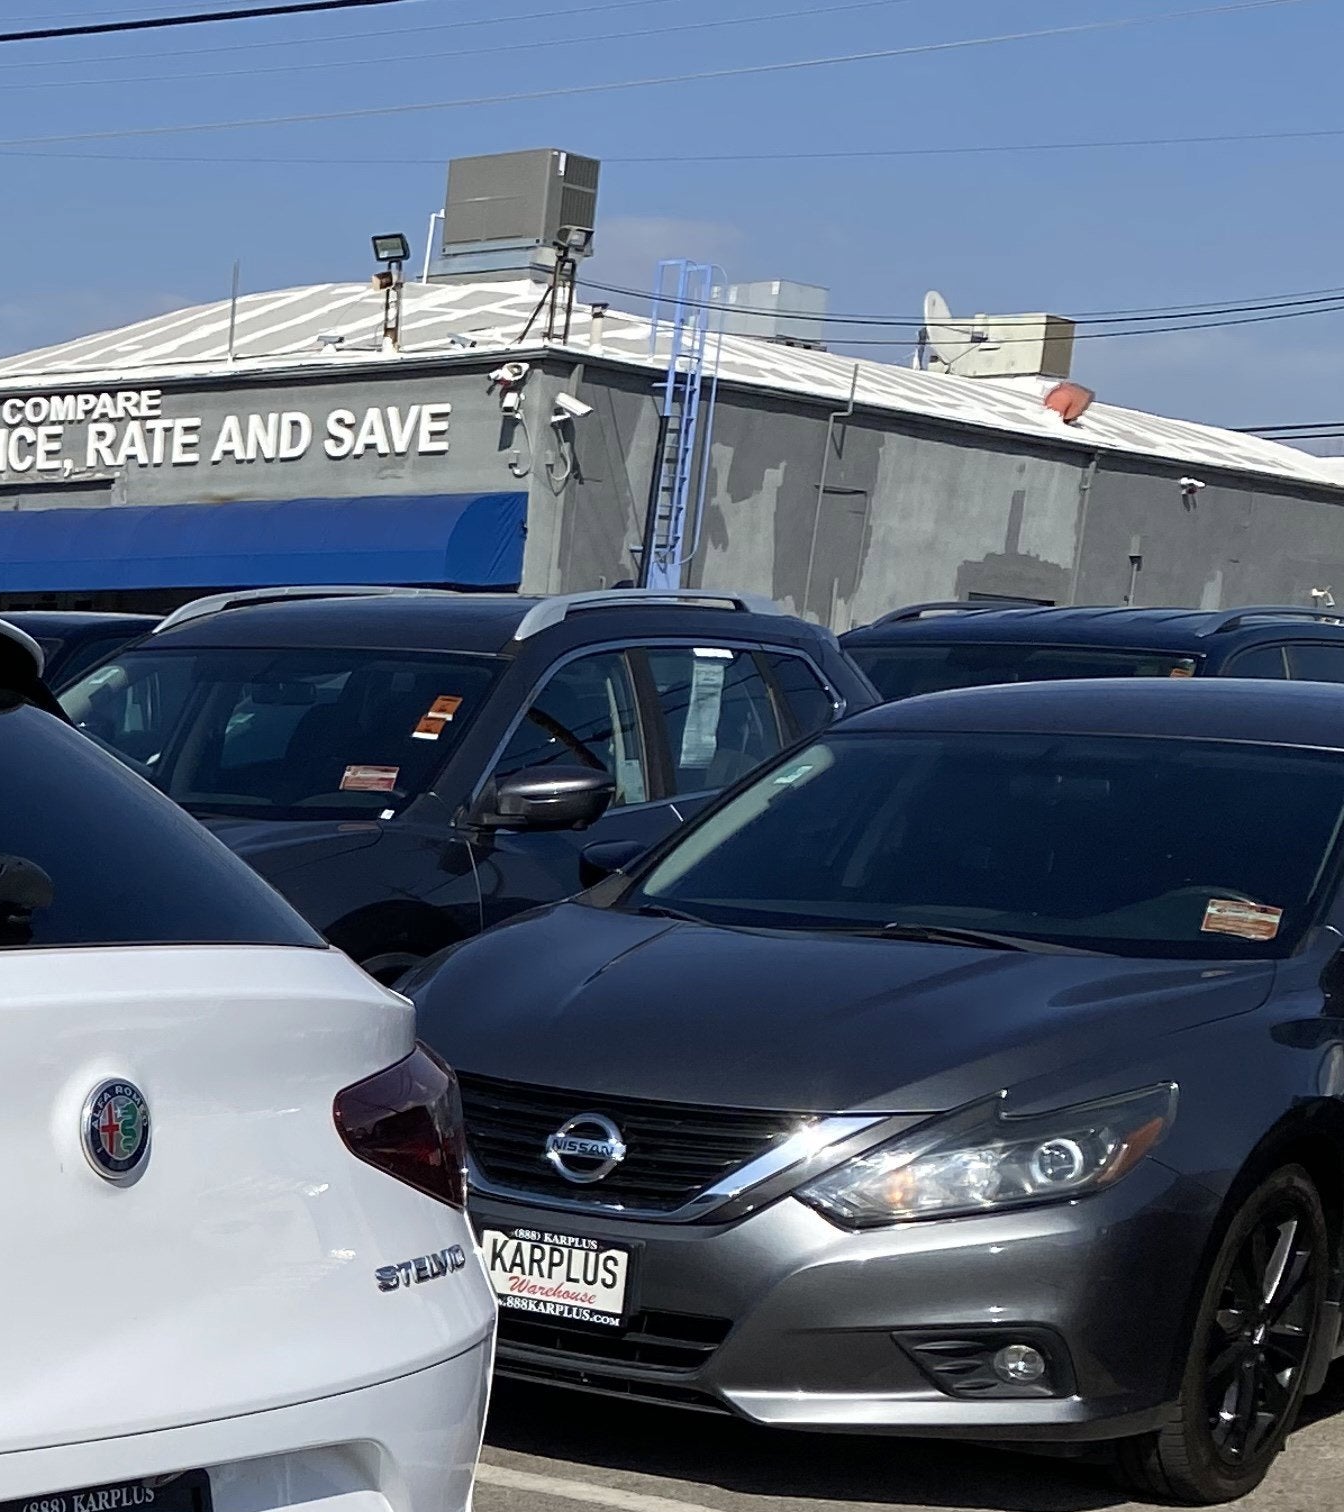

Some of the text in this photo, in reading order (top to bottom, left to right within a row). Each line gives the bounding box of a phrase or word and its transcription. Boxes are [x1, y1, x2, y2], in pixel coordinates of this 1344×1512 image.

[2, 389, 162, 426] COMPARE
[86, 416, 202, 468] RATE
[210, 410, 313, 465] AND
[323, 403, 452, 461] SAVE
[91, 1092, 112, 1130] ALFA
[551, 1138, 615, 1157] NISSAN
[514, 1228, 598, 1250] (888) KARPLUS
[490, 1238, 619, 1289] KARPLUS
[508, 1275, 597, 1305] Warehouse
